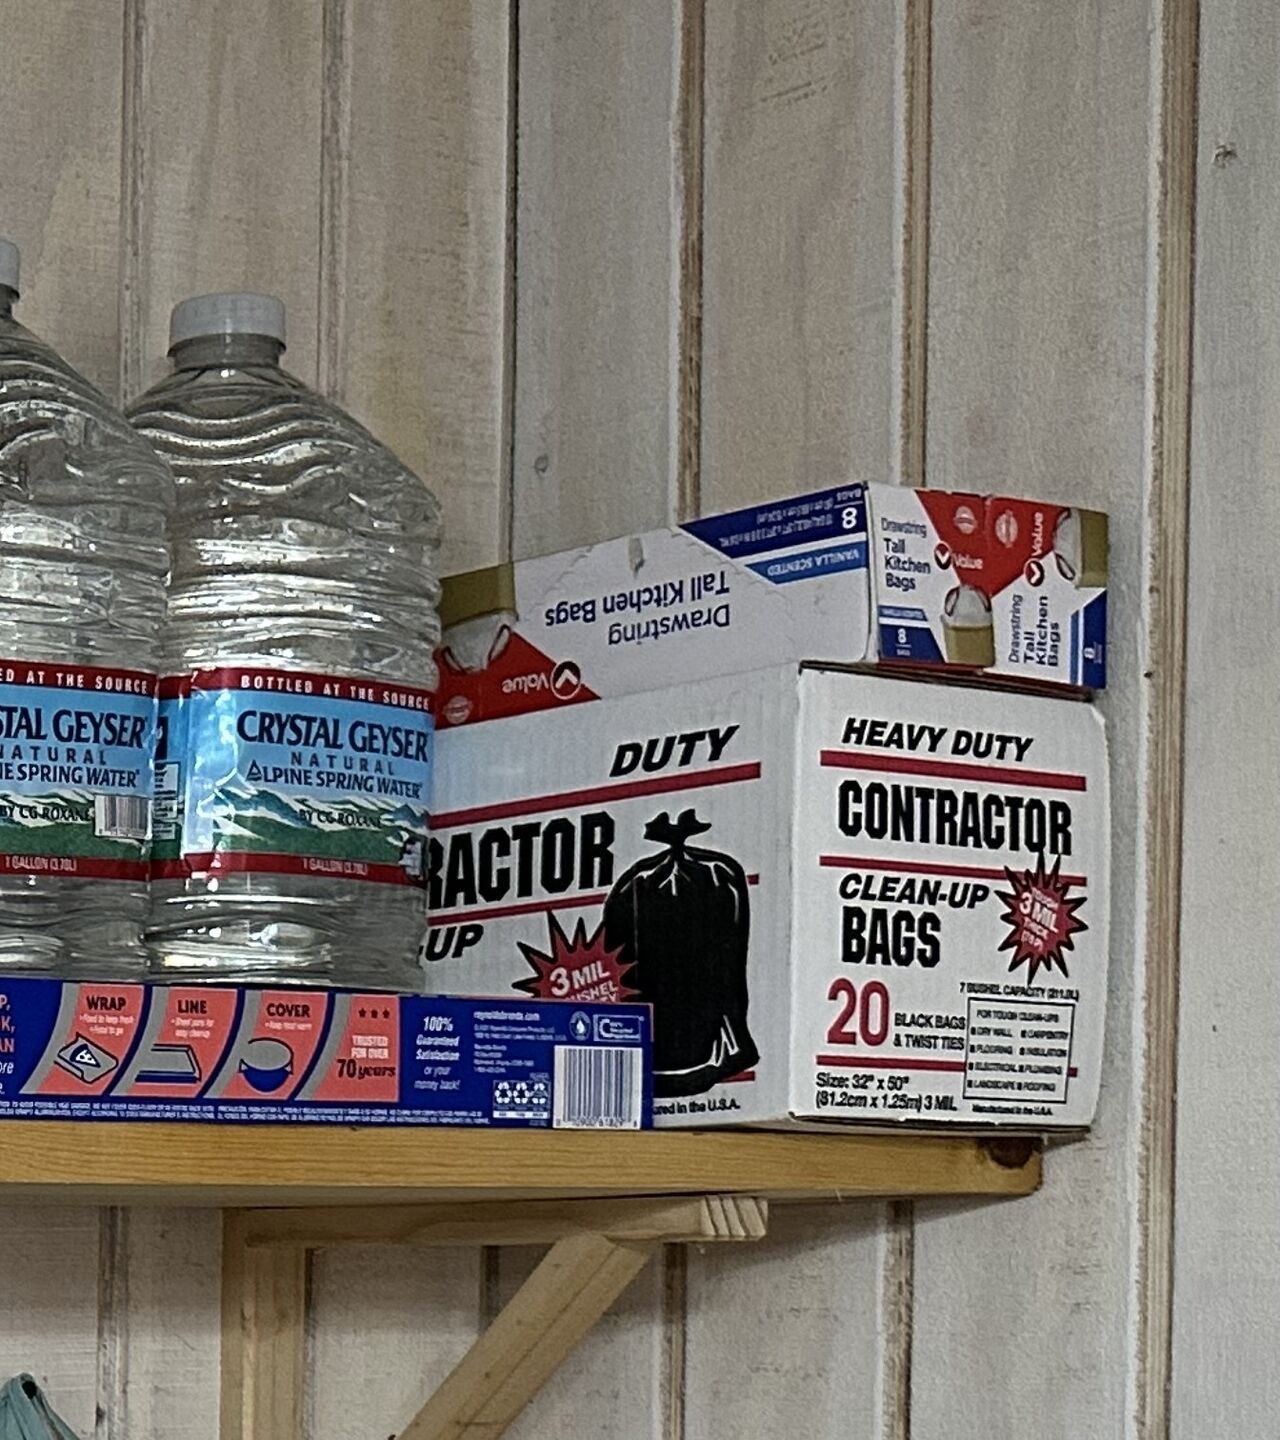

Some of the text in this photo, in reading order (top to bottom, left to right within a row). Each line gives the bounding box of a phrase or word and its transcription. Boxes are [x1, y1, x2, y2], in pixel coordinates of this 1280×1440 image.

[841, 507, 858, 529] 8
[881, 517, 927, 538] Drawstring
[1031, 511, 1044, 556] Value
[884, 538, 906, 554] Tall
[767, 549, 860, 576] VANILLA SCENTED
[884, 555, 931, 575] Kitchen
[952, 553, 983, 570] Value
[886, 572, 916, 592] Bags
[545, 570, 730, 627] Tall Kitchen Bags
[608, 603, 730, 645] Drawstring
[1009, 594, 1023, 663] Drawstring
[1035, 595, 1048, 665] Kitchen
[1024, 631, 1036, 663] Tall
[1047, 622, 1061, 667] Bags
[26, 671, 46, 683] AT
[56, 673, 85, 688] THE
[95, 675, 148, 695] SOURCE
[240, 675, 313, 694] BOTTLED
[323, 683, 340, 696] AT
[351, 686, 374, 702] THE
[382, 690, 430, 711] SOURCE
[502, 672, 549, 694] Value
[53, 709, 146, 750] GEYSER
[236, 710, 429, 763] CRYSTAL GEYSER
[842, 718, 1034, 762] HEAVY DUTY
[609, 725, 740, 778] DUTY
[291, 752, 395, 776] NATURAL
[17, 763, 84, 785] SPRING
[87, 768, 137, 789] WATER
[246, 760, 422, 800] ALPINE SPRING WATER
[0, 805, 14, 818] BY
[838, 780, 1072, 856] CONTRACTOR
[5, 856, 48, 870] 1 GALLON
[303, 858, 308, 869] 1
[428, 811, 616, 910] RACTOR
[839, 873, 990, 908] CLEAN-UP
[1020, 892, 1059, 933] 3 MIL
[842, 906, 941, 968] BAGS
[550, 960, 611, 997] 3 MIL
[1003, 985, 1045, 998] CAPACITY
[86, 995, 126, 1011] WRAP
[177, 999, 207, 1014] LINE
[266, 1003, 310, 1018] COVER
[827, 977, 890, 1046] 20
[423, 1016, 453, 1031] 100%
[894, 1013, 966, 1029] BLACK BAGS
[352, 1035, 388, 1047] TRUSTED
[416, 1034, 460, 1047] Guaranteed
[893, 1034, 965, 1050] & TWIST TIES
[351, 1048, 388, 1059] FOR OVER
[416, 1049, 460, 1061] Satisfaction
[337, 1059, 396, 1080] 70 years
[433, 1066, 451, 1077] your
[414, 1080, 438, 1091] money
[816, 1072, 910, 1091] Size: 32" x 50"
[677, 1102, 687, 1113] in
[689, 1101, 706, 1113] the
[708, 1099, 741, 1111] U.S.A.
[816, 1090, 958, 1113] (81.2cm x 1.25m) 3 MIL
